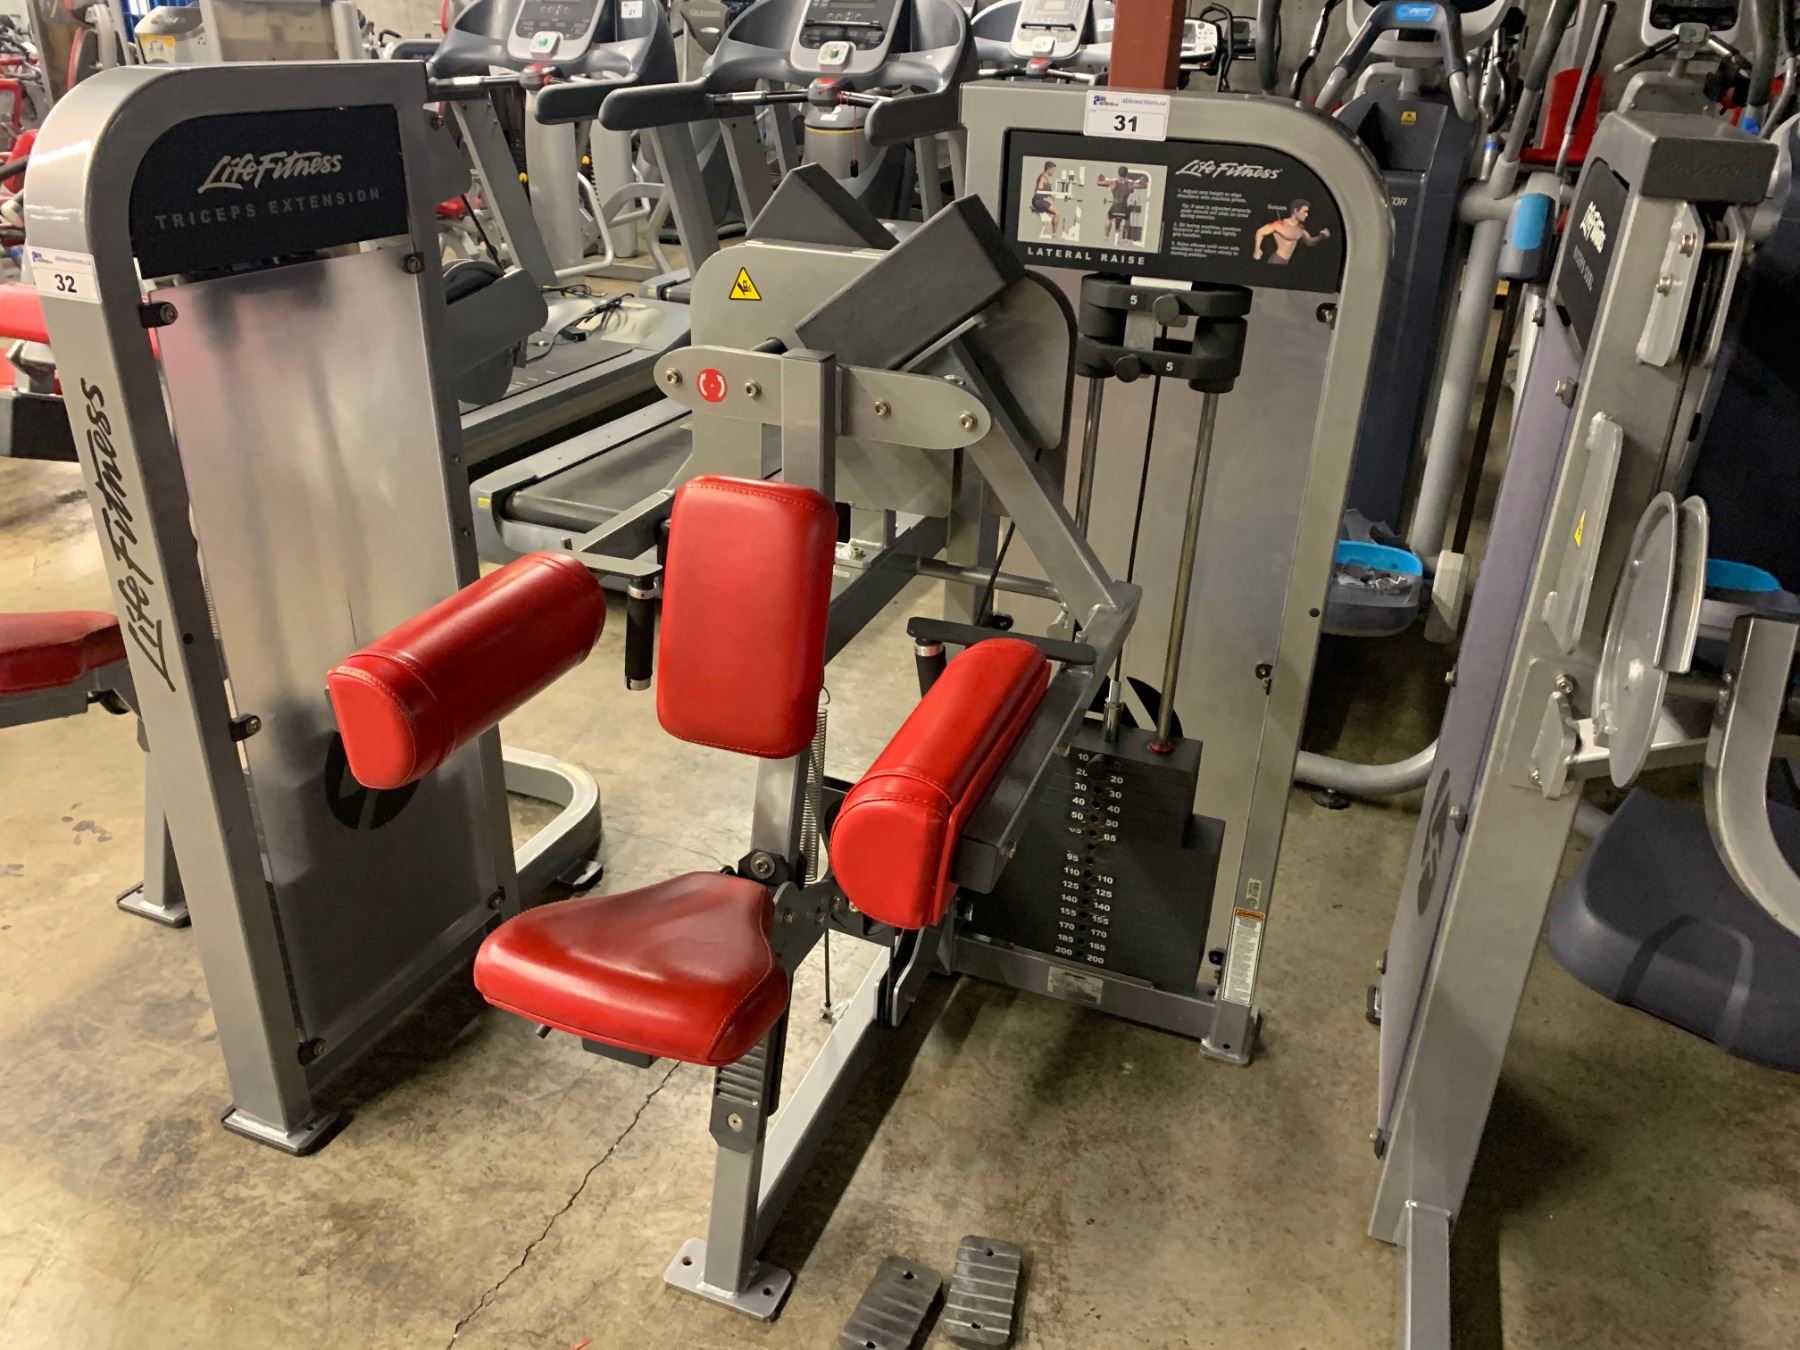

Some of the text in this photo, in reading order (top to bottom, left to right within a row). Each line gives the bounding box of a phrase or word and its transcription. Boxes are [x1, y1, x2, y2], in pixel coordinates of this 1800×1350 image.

[1113, 114, 1138, 132] 31
[155, 187, 381, 230] TRICEPS EXTENSION
[1027, 247, 1145, 265] LATERAL RAISE
[54, 273, 77, 293] 32
[1130, 295, 1138, 305] 5
[1166, 361, 1174, 371] 5
[1078, 753, 1089, 761] 10
[1110, 775, 1124, 784] 20
[1074, 782, 1087, 791] 30
[1109, 790, 1122, 799] 30
[1072, 797, 1085, 806] 40
[1106, 805, 1120, 814] 40
[1071, 811, 1084, 820] 50
[1105, 819, 1119, 828] 50
[1066, 853, 1079, 862] 95
[1064, 866, 1080, 877] 110
[1097, 874, 1114, 884] 110
[1062, 880, 1080, 890] 125
[1061, 893, 1078, 903] 140
[1095, 888, 1113, 899] 125
[1093, 901, 1111, 912] 140
[1060, 907, 1077, 917] 155
[1059, 921, 1075, 931] 170
[1058, 933, 1074, 943] 185
[1090, 928, 1107, 939] 170
[1055, 945, 1073, 956] 200
[1089, 941, 1106, 952] 185
[1086, 953, 1105, 965] 200
